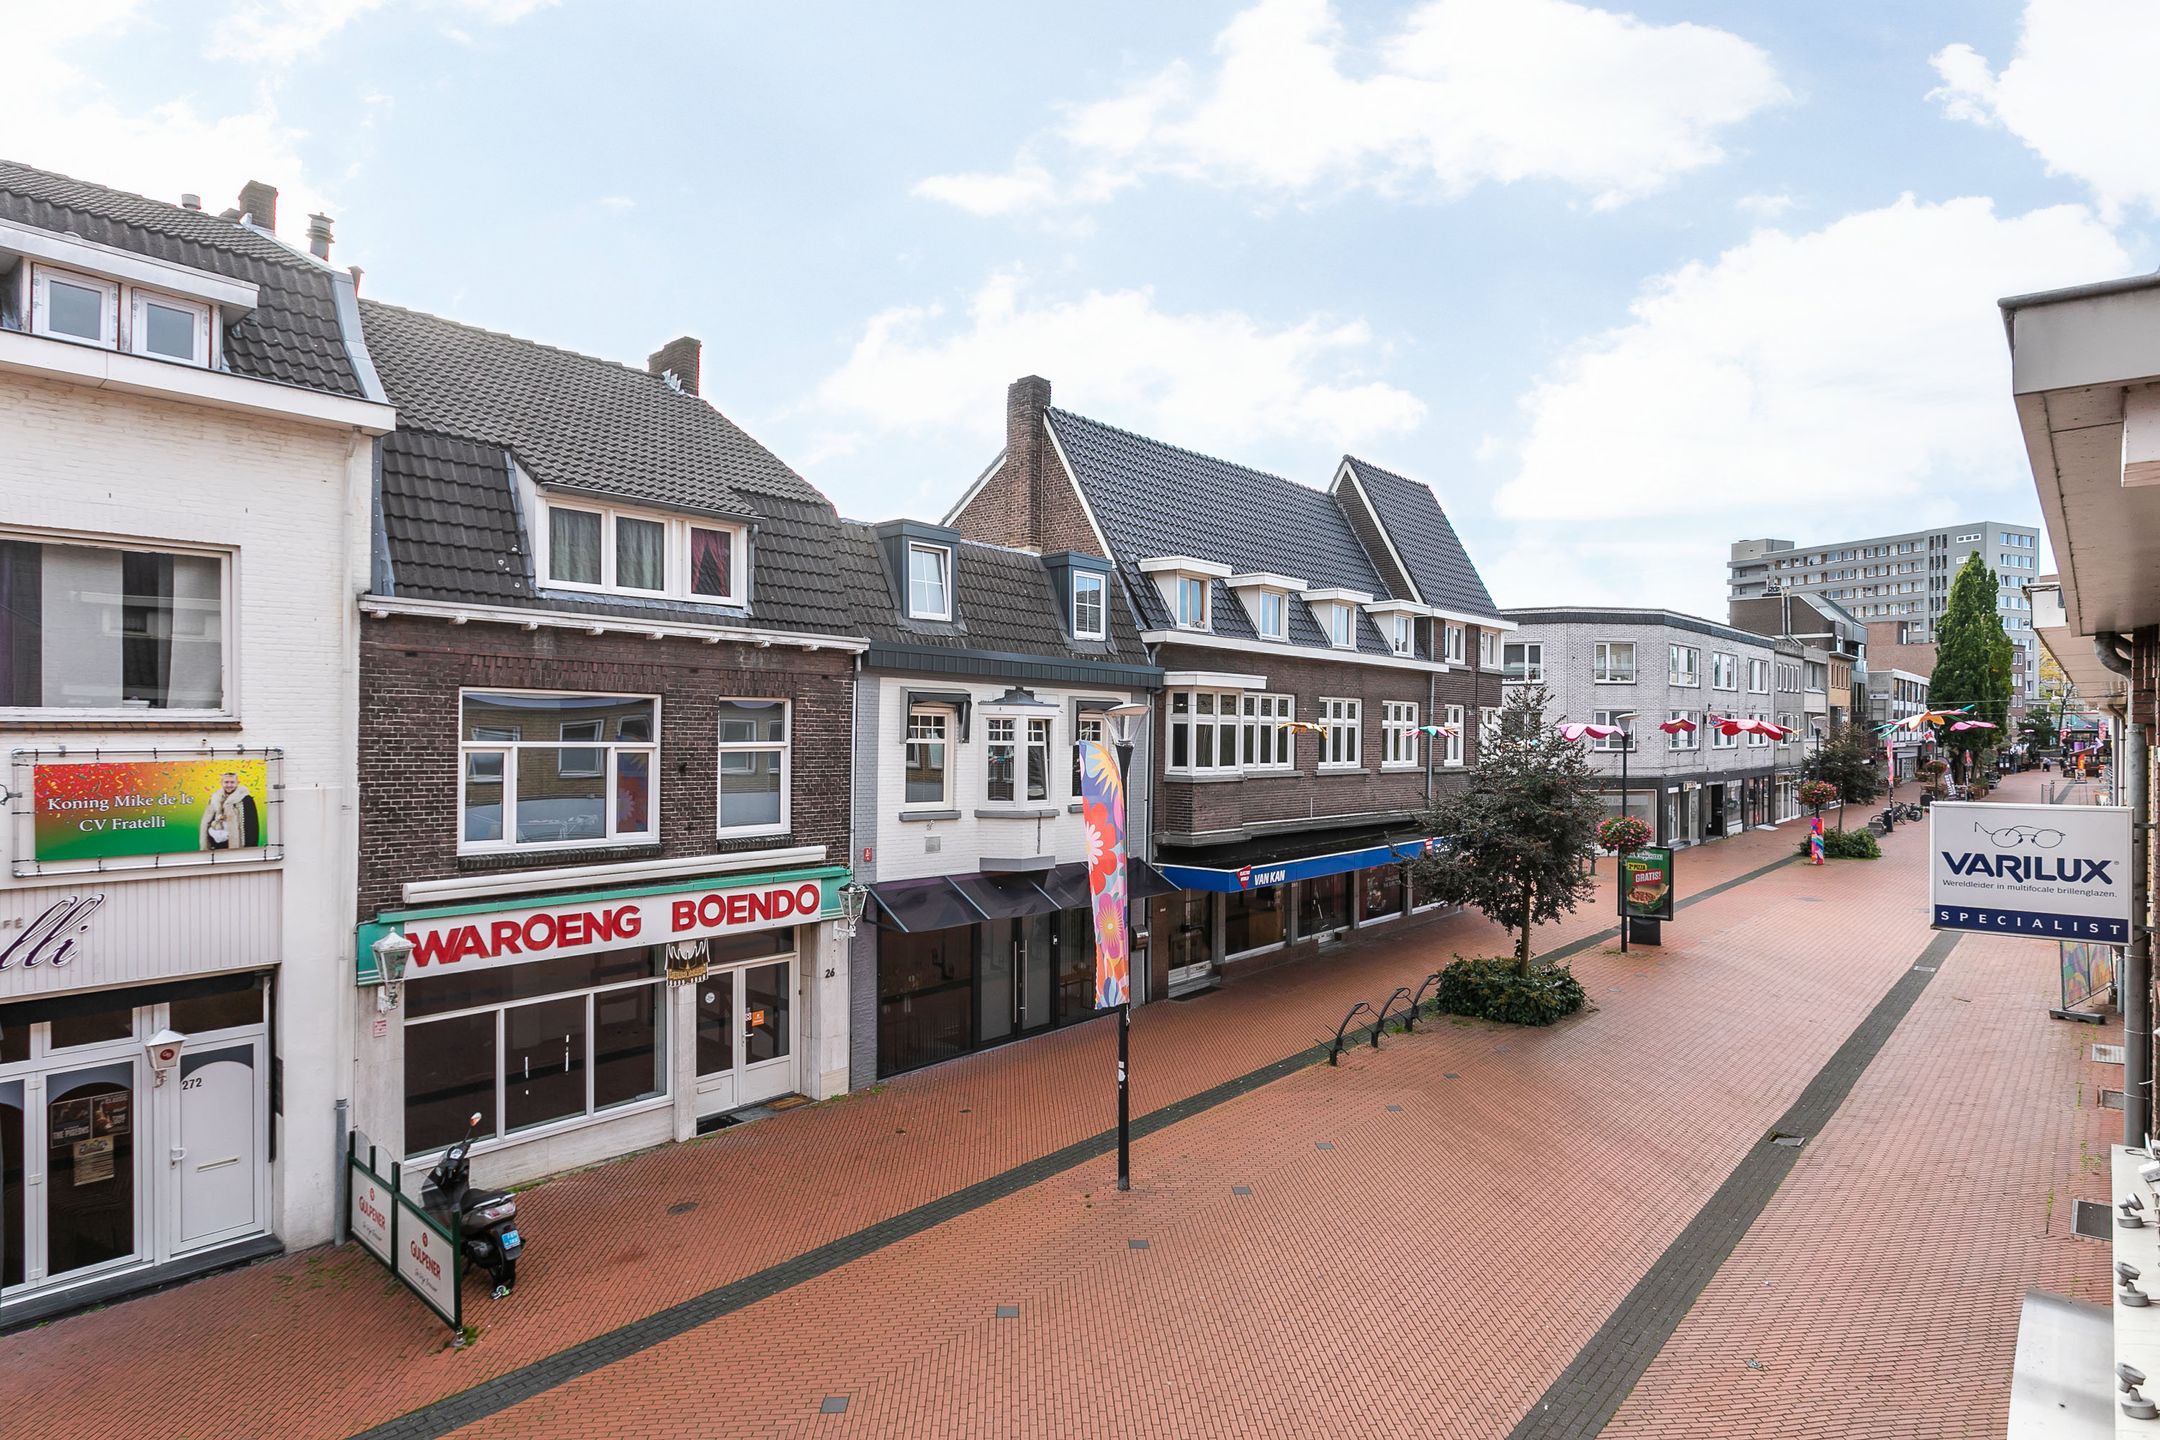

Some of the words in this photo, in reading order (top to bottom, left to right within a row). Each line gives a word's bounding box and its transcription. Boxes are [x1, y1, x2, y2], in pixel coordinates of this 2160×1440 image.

[47, 797, 109, 812] Koning
[114, 793, 154, 808] Mike
[158, 793, 176, 806] de
[180, 791, 195, 805] le
[79, 818, 107, 832] CV
[112, 815, 166, 831] Fratelli
[1254, 872, 1269, 886] VAN
[1270, 869, 1286, 883] KAN
[1635, 870, 1662, 883] GRATIS!
[1941, 851, 2113, 885] VARILUX
[1942, 879, 1994, 890] Wereldleider
[1996, 882, 2005, 890] in
[2007, 883, 2055, 894] multifocale
[2057, 886, 2118, 899] brillenglazen.
[405, 905, 642, 968] WAROENG
[672, 883, 820, 933] BOENDO
[1940, 910, 2121, 935] SPECIALIST
[825, 967, 836, 979] 26
[182, 1077, 202, 1091] 272
[359, 1195, 386, 1230] GULPENER
[410, 1240, 442, 1280] GULPENER
